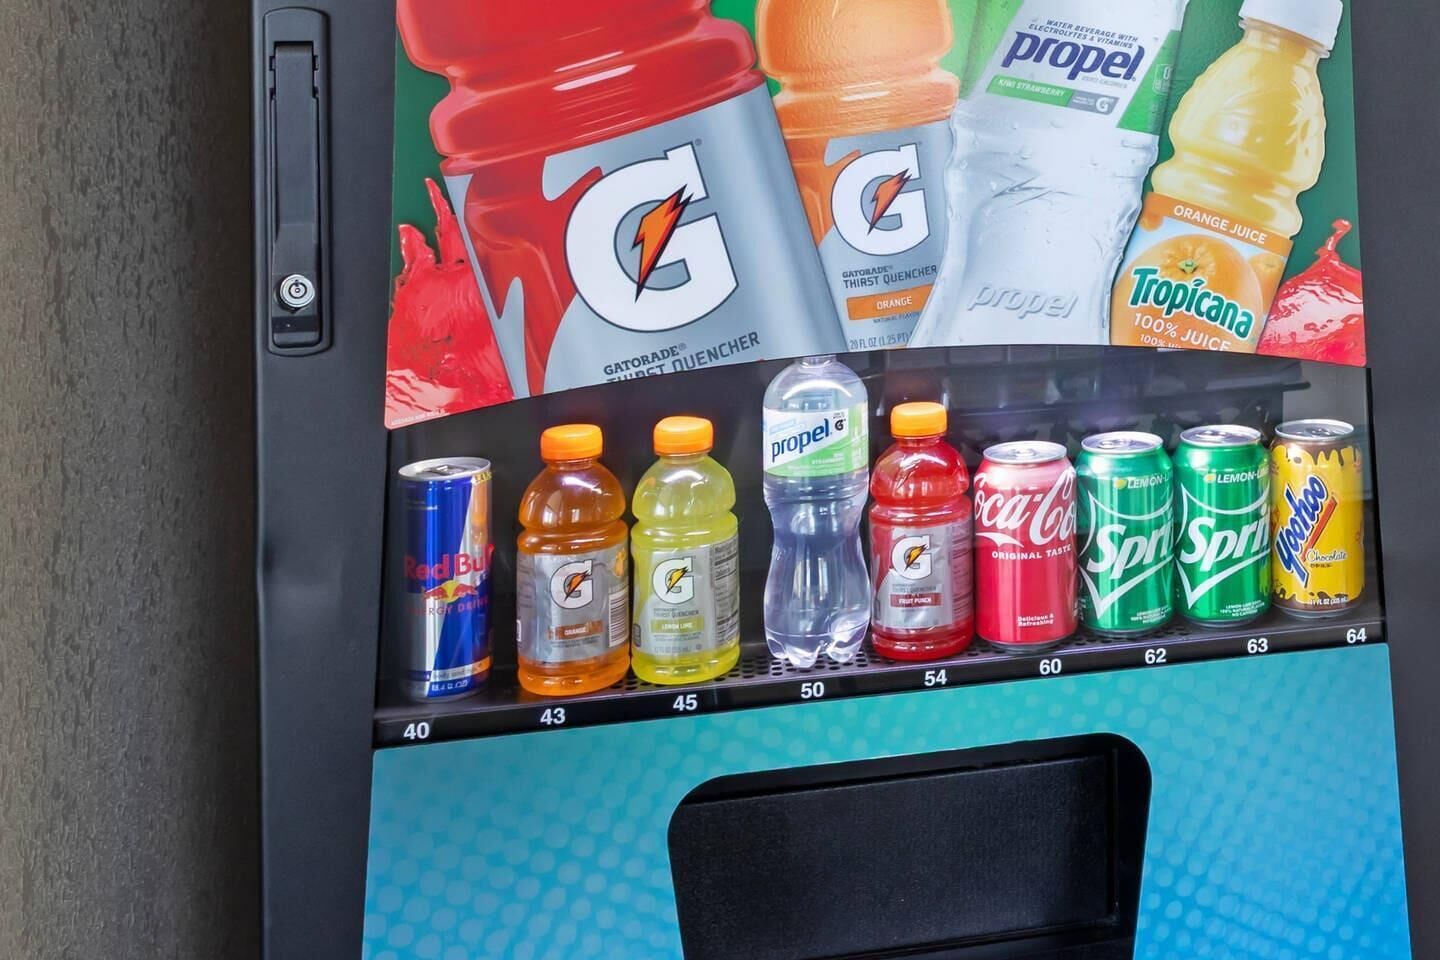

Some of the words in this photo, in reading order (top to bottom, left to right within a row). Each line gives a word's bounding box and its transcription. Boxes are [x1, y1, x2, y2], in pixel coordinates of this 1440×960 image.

[1028, 23, 1087, 40] ELECTROLYTES
[1097, 36, 1133, 49] VITAMINS
[1046, 19, 1073, 31] WATER
[1075, 24, 1116, 37] BEVERAGE
[1118, 31, 1139, 42] WITH
[1000, 31, 1146, 81] propel
[998, 78, 1014, 87] KIWI
[1016, 81, 1066, 97] STRAWBERRY
[831, 144, 930, 257] G
[1173, 204, 1230, 231] ORANGE
[1229, 223, 1268, 245] JUICE
[565, 141, 739, 334] G
[843, 277, 882, 289] THIRST
[883, 264, 938, 286] QUENCHER
[876, 296, 913, 311] ORANGE
[967, 281, 1078, 321] propel
[1129, 267, 1254, 339] Tropicana
[1134, 312, 1180, 338] 100%
[850, 339, 858, 350] 20
[859, 338, 868, 349] FL
[868, 337, 877, 348] OZ
[879, 334, 897, 347] (1.25
[771, 418, 830, 463] propel
[891, 534, 933, 581] G
[991, 550, 1042, 560] ORIGINAL
[1046, 543, 1072, 557] TASTE
[1307, 549, 1347, 563] Chocolate
[404, 554, 450, 580] Red
[550, 558, 594, 610] G
[652, 555, 695, 605] G
[564, 627, 587, 636] ORANGE
[1017, 618, 1054, 627] Refreshing
[1346, 626, 1367, 644] 64
[1247, 637, 1269, 654] 63
[1144, 647, 1167, 665] 62
[1039, 658, 1062, 676] 60
[924, 669, 948, 687] 54
[800, 681, 825, 699] 50
[673, 694, 698, 712] 45
[540, 707, 566, 726] 43
[404, 721, 430, 740] 40
